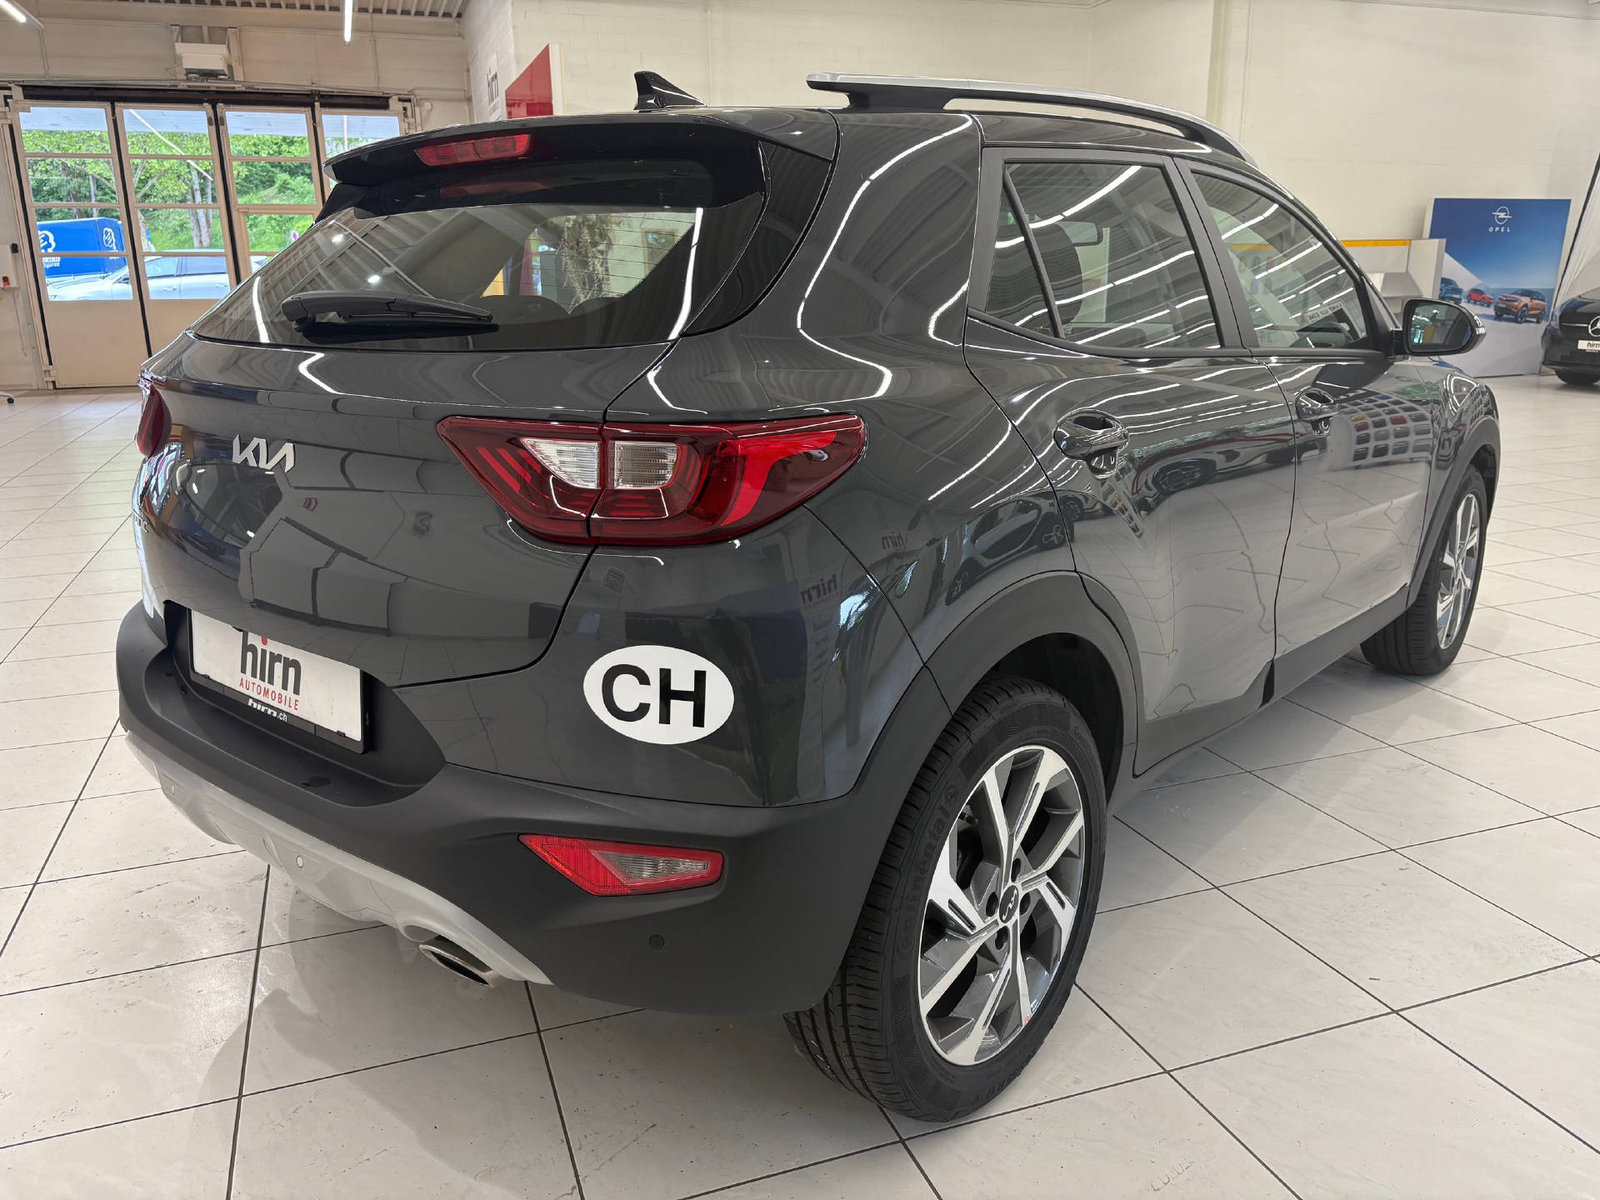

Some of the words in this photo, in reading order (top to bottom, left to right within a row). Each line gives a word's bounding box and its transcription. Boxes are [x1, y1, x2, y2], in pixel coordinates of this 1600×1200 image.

[232, 434, 296, 474] KIA
[240, 631, 302, 696] hirn
[239, 677, 300, 711] AUTOMOBILE
[247, 698, 288, 723] hirn.ch
[601, 663, 707, 728] CH
